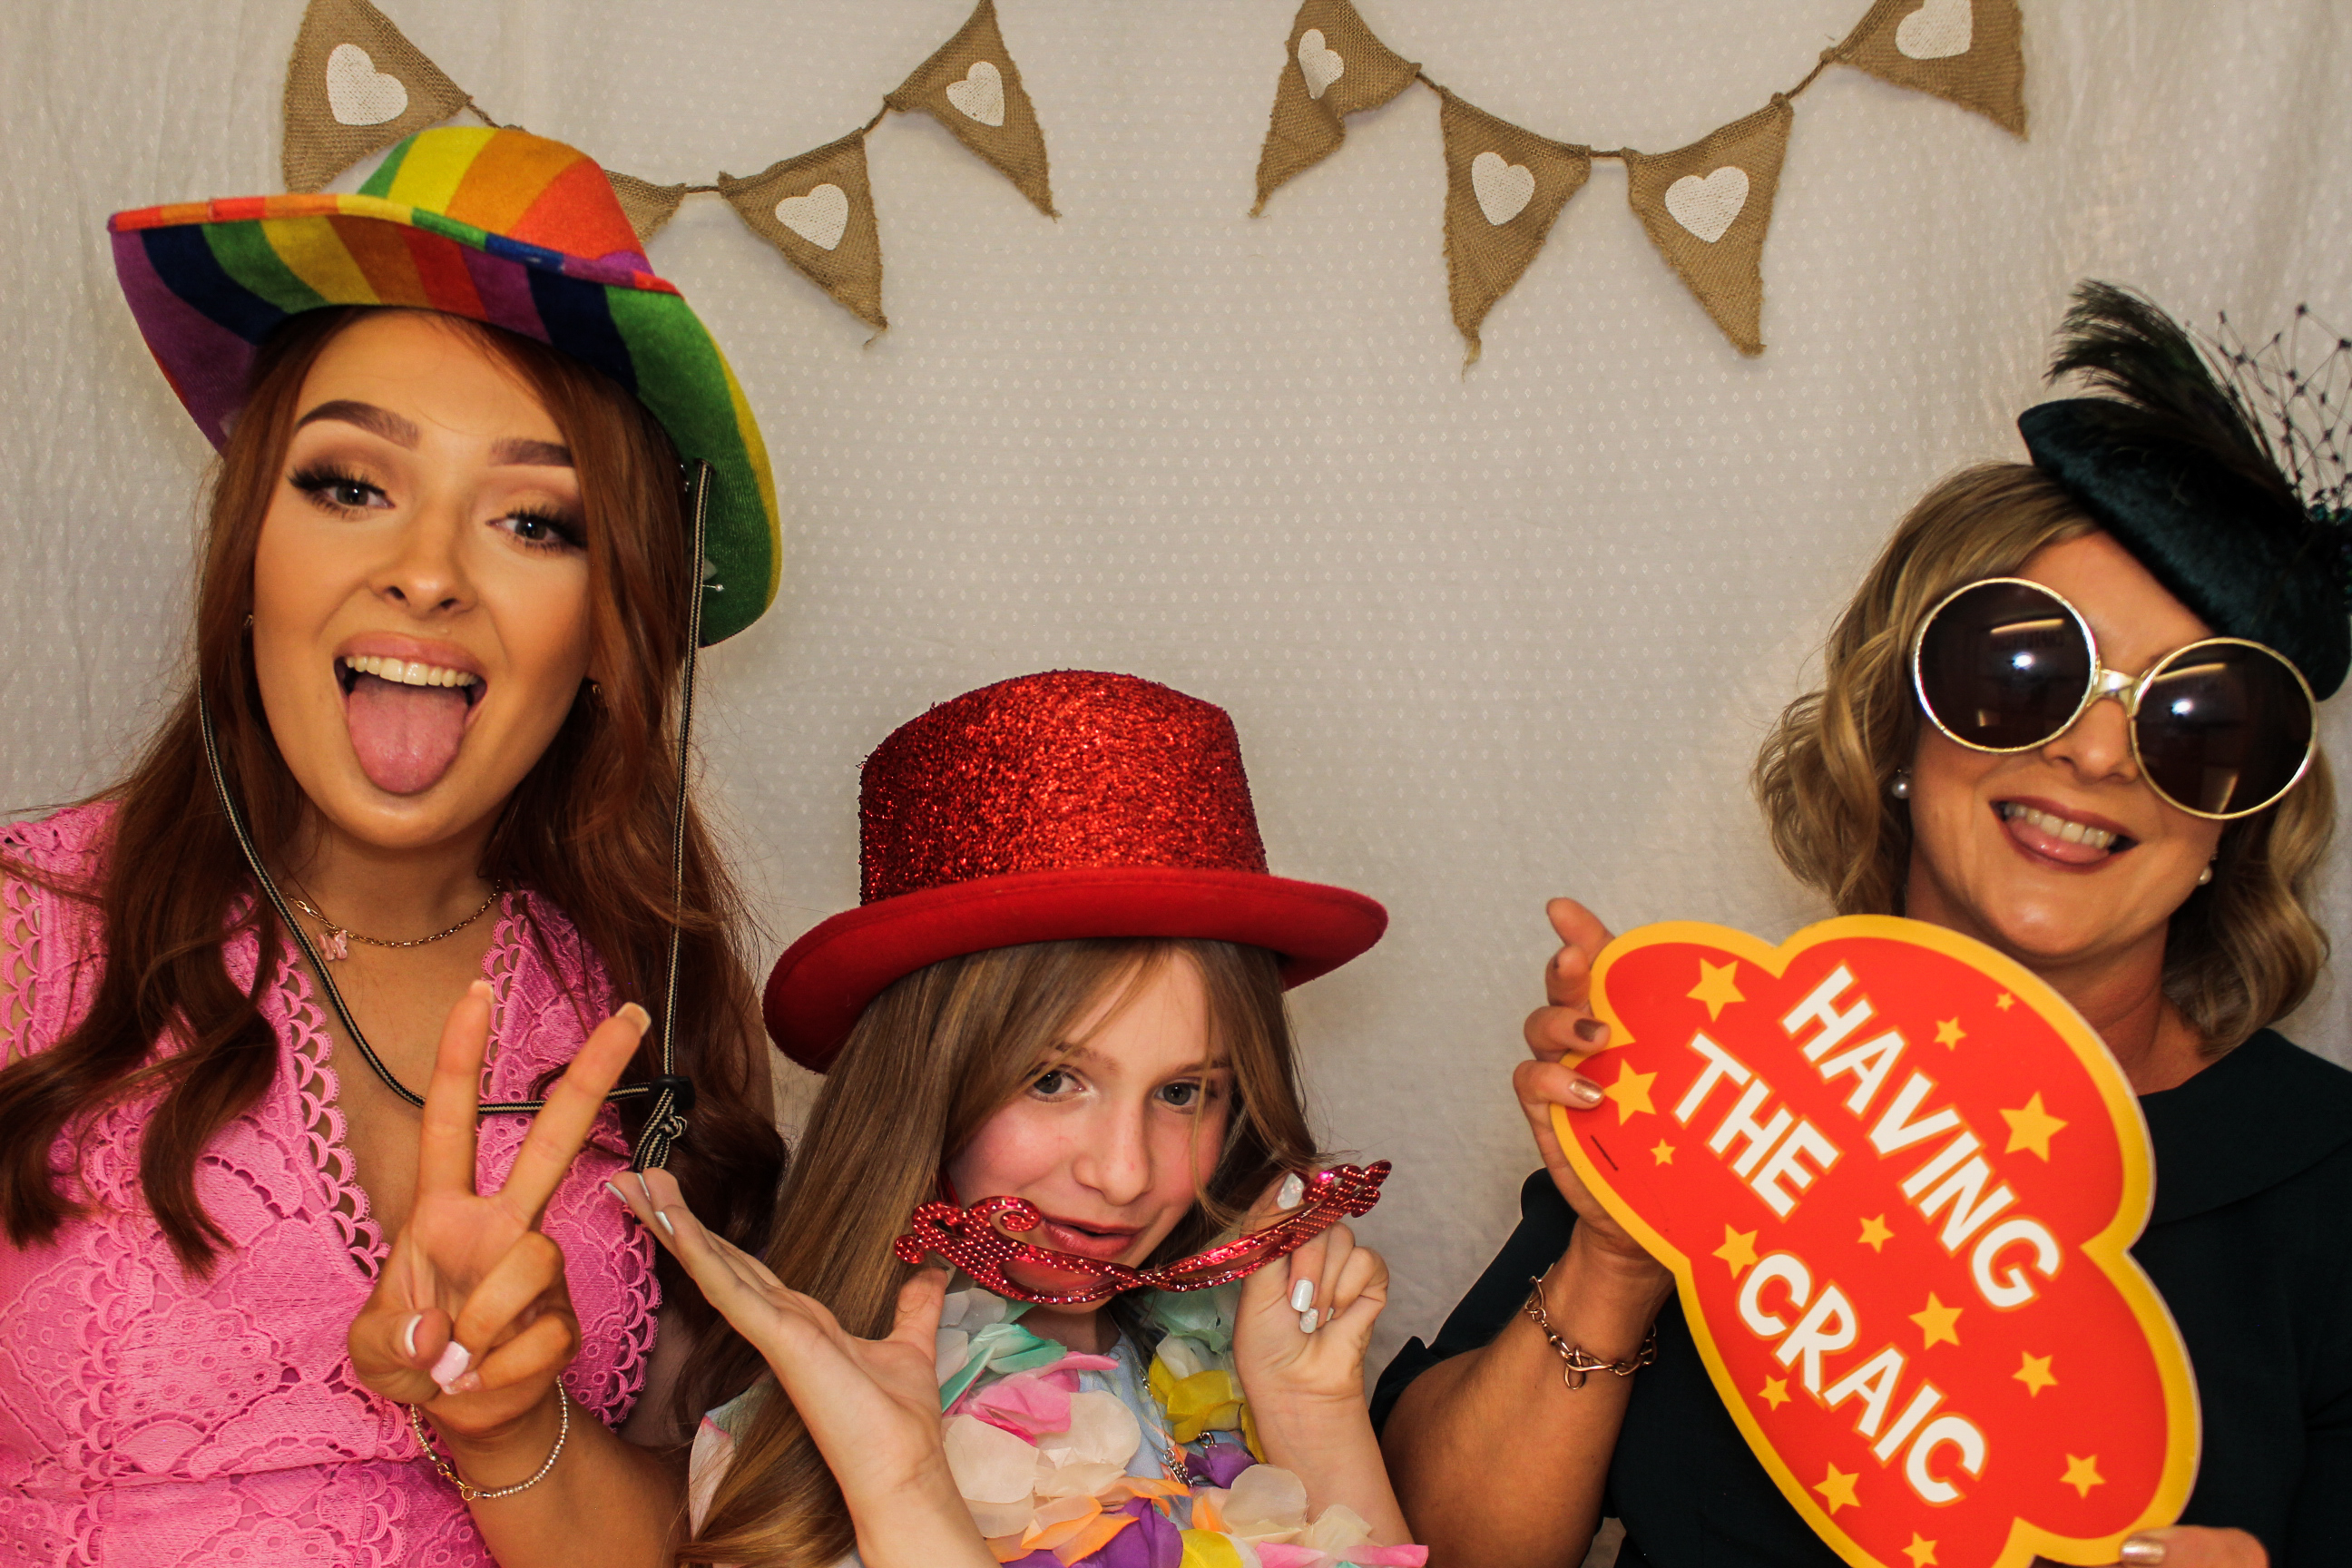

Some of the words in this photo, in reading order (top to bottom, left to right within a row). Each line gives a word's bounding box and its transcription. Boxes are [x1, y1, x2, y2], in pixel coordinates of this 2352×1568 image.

[1674, 1033, 1839, 1218] THE
[1782, 965, 2060, 1308] HAVING
[1739, 1253, 1985, 1504] CRAIC
